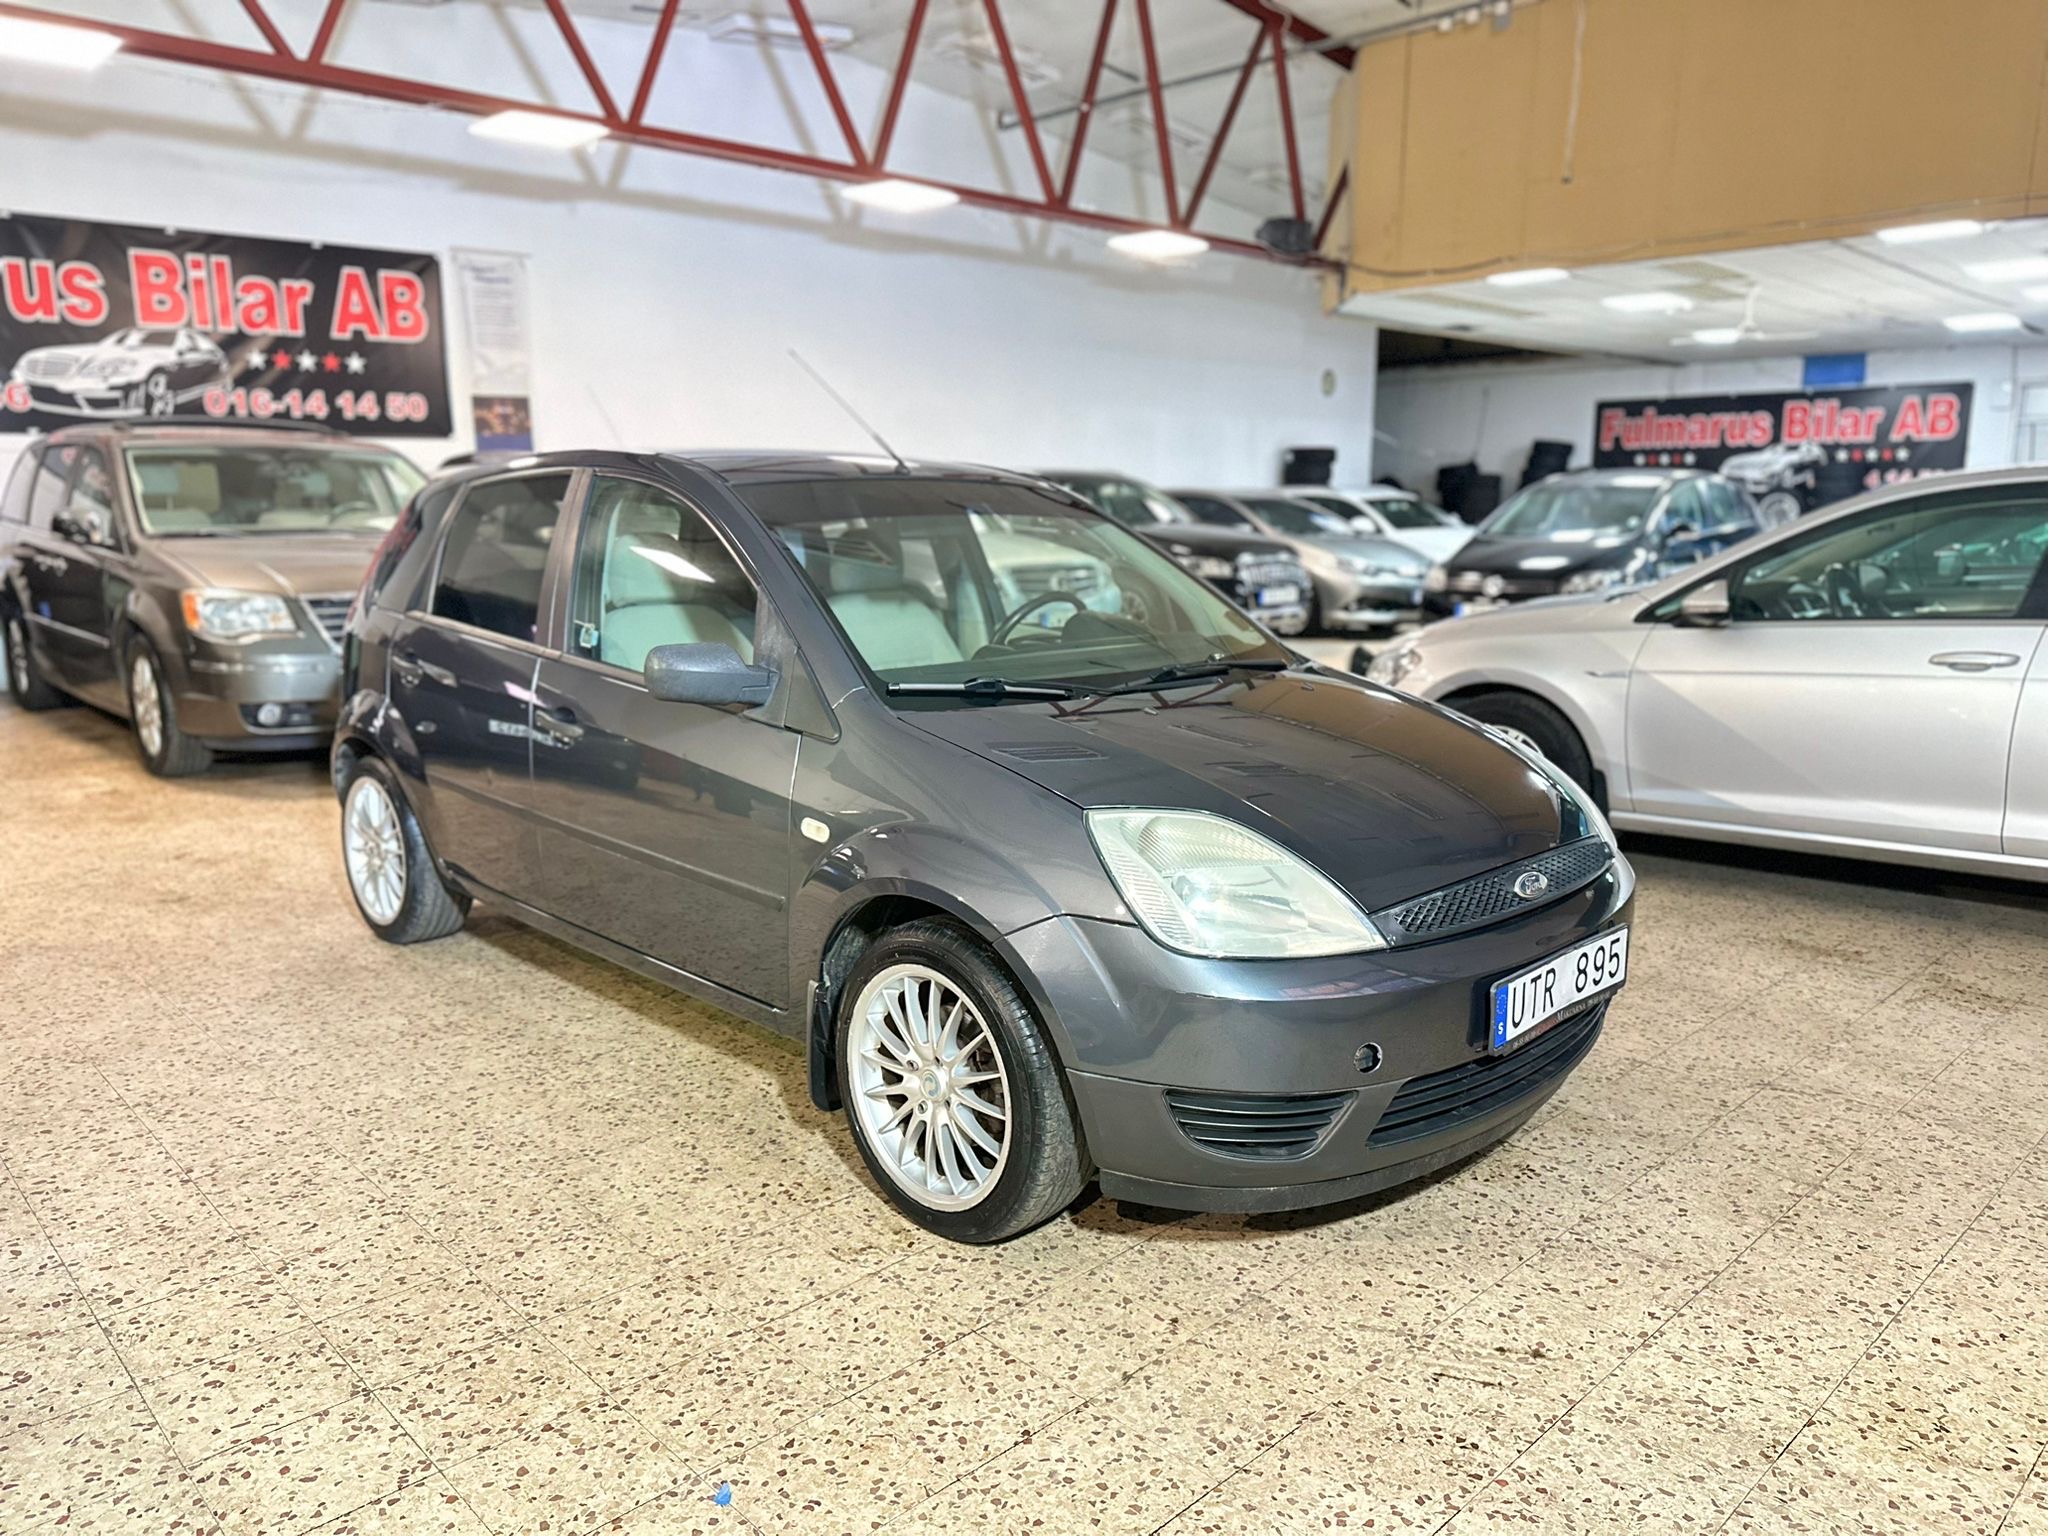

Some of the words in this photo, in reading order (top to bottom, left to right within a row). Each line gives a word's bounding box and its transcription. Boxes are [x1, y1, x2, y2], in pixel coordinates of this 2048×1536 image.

[128, 247, 312, 337] Bilar
[331, 265, 428, 343] AB
[335, 390, 380, 421] 14
[1600, 407, 1773, 451] Fulmarus
[1782, 399, 1885, 443] Bilar
[1890, 393, 1960, 442] AB
[1511, 968, 1556, 1029] UTR
[1575, 937, 1621, 993] 895
[1497, 1021, 1505, 1035] S
